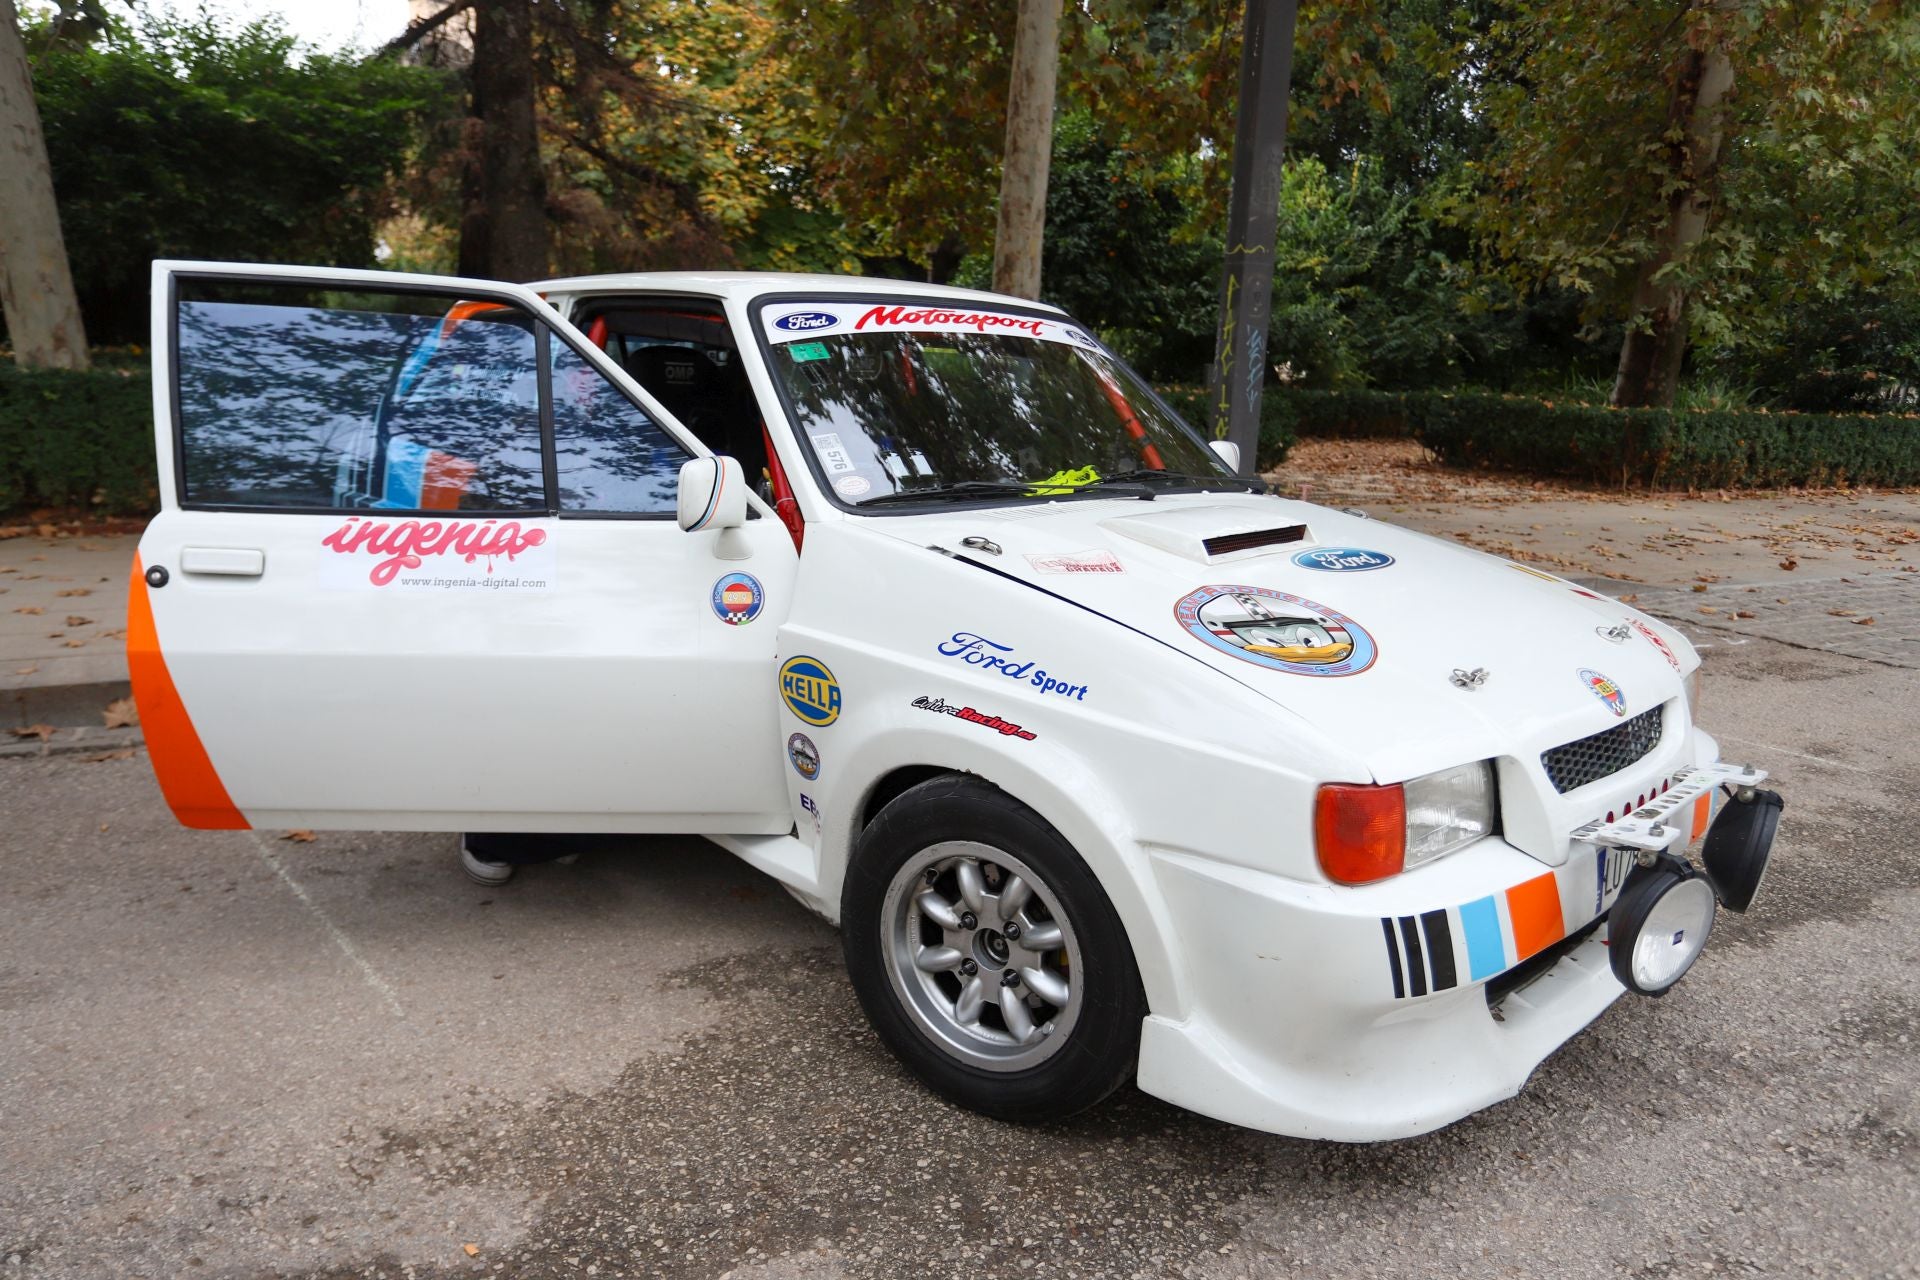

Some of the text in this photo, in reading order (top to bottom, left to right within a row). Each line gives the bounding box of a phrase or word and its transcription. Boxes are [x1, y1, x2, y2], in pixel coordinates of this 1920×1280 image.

[788, 306, 1057, 336] Ford Motorsport
[827, 450, 848, 470] 576
[322, 518, 547, 586] ingenia
[1311, 551, 1381, 569] Ford
[401, 576, 547, 589] www.ingenia-digital.com
[937, 632, 1089, 701] Ford Sport
[784, 674, 842, 717] HELLA
